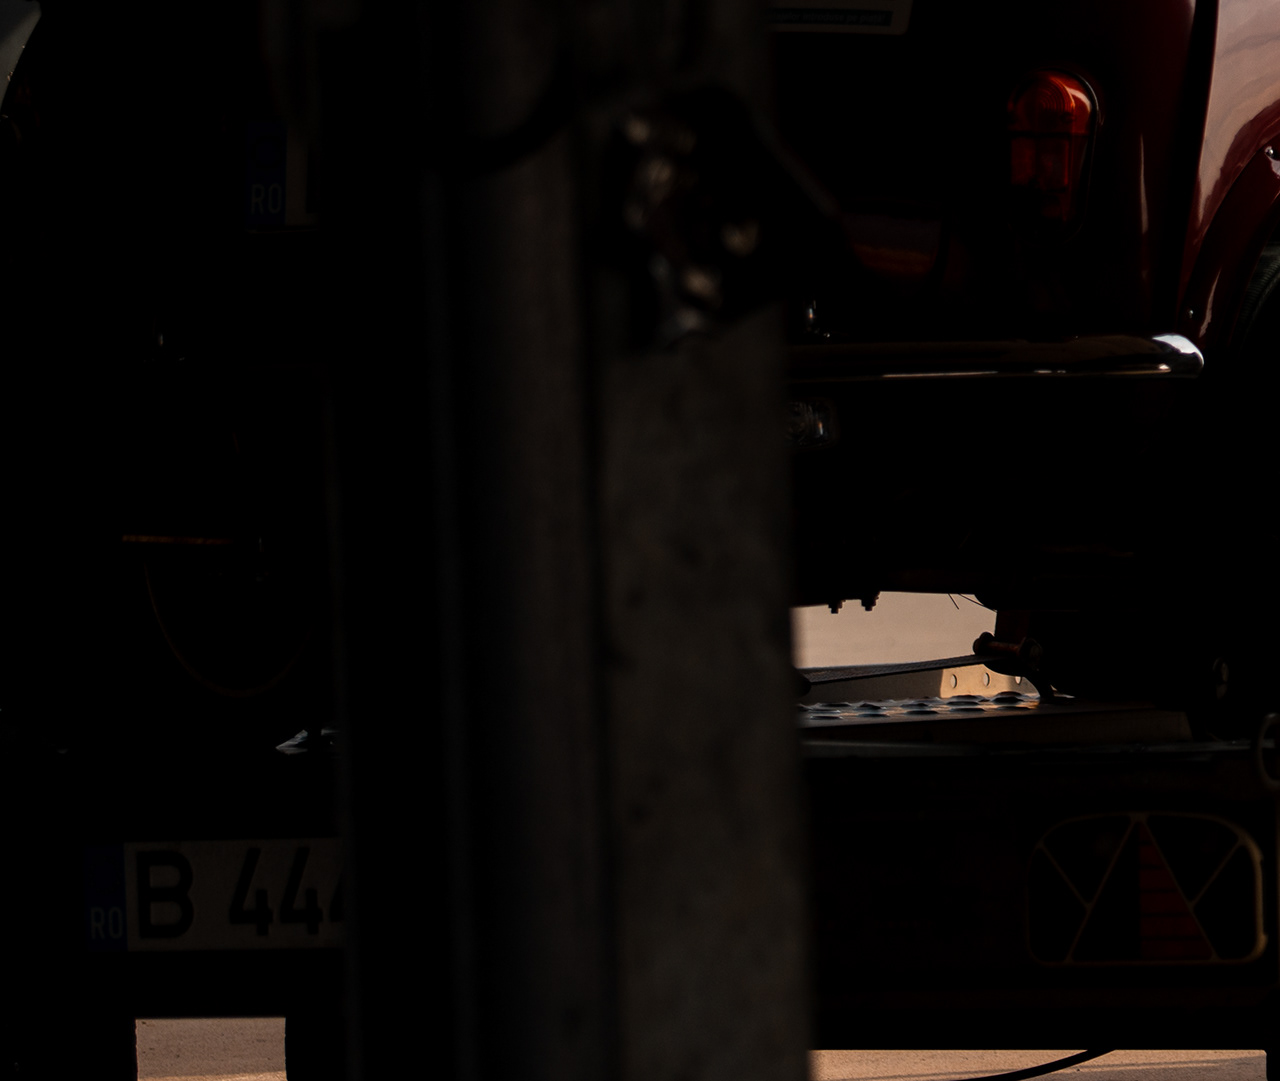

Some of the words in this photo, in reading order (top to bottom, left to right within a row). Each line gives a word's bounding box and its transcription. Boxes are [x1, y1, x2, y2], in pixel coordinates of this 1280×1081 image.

[251, 183, 282, 215] RO
[90, 907, 123, 940] RO
[135, 849, 195, 940] B
